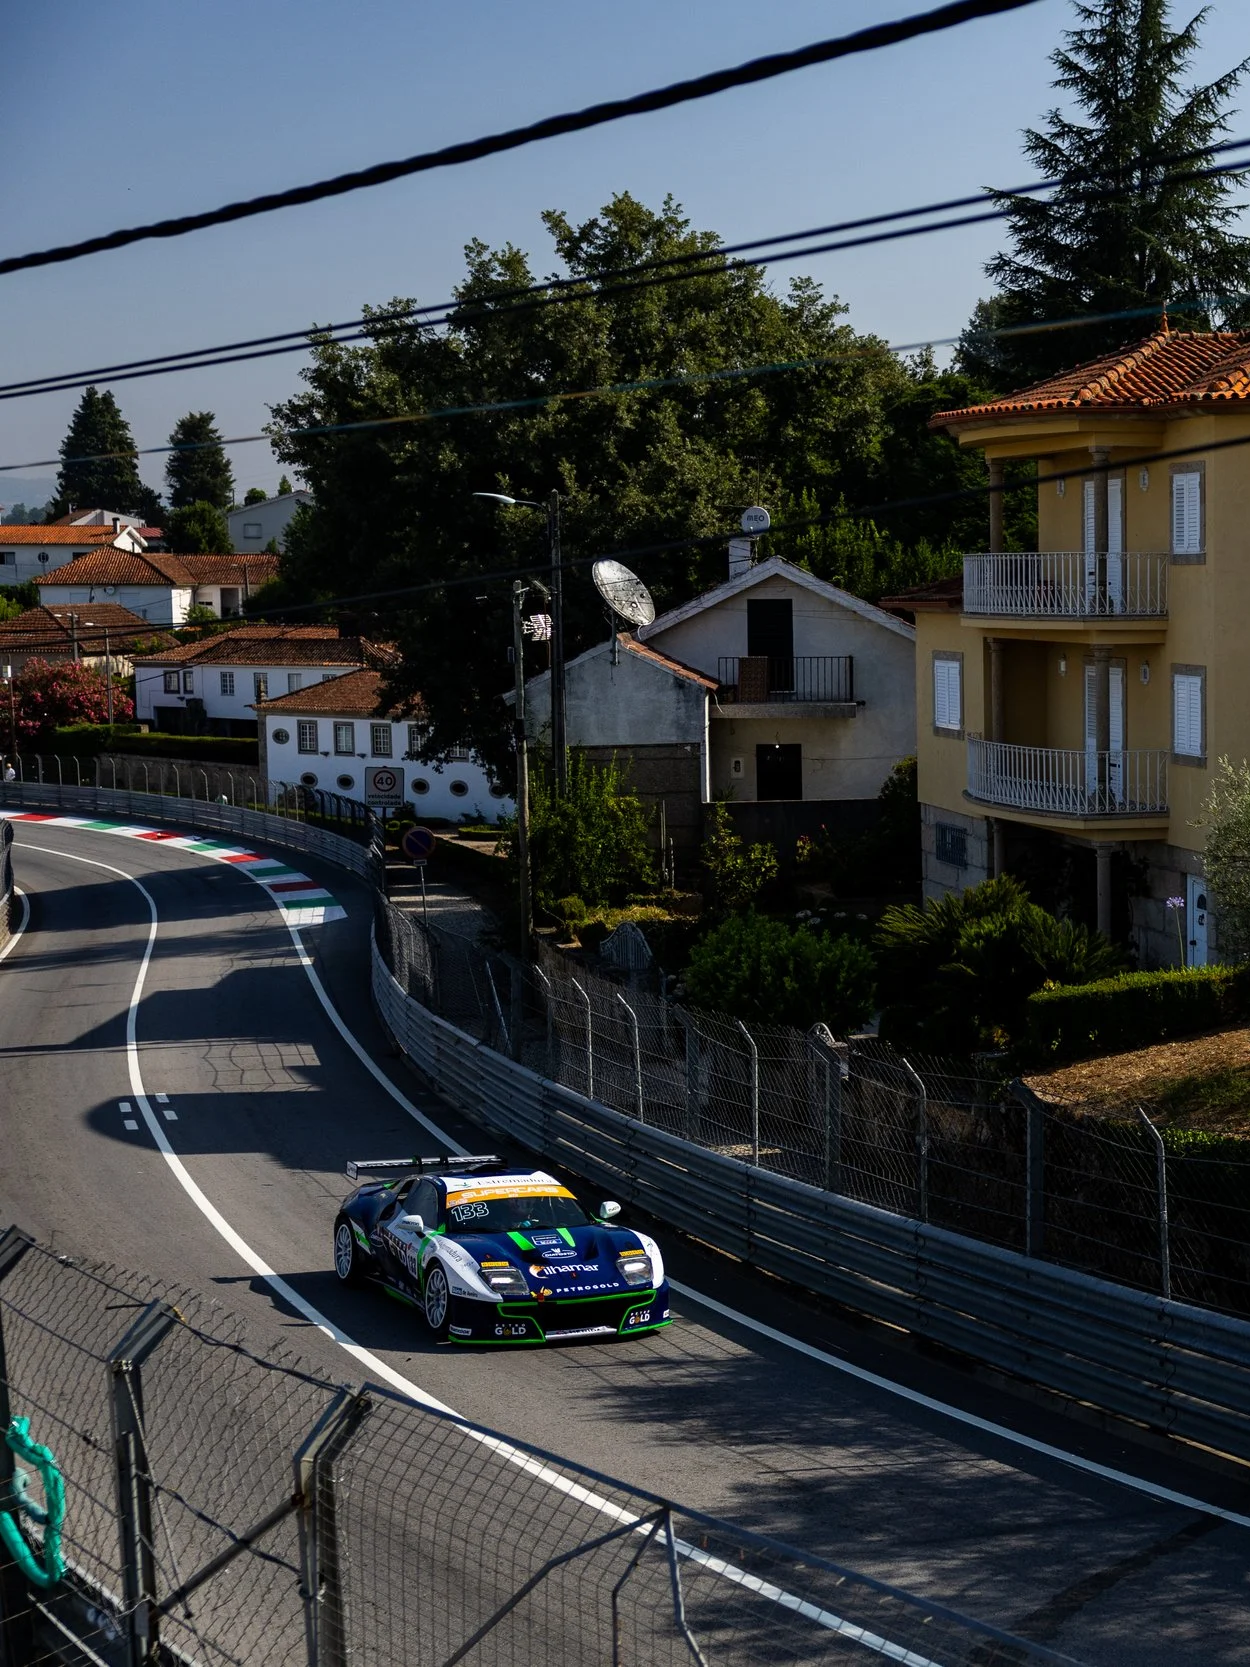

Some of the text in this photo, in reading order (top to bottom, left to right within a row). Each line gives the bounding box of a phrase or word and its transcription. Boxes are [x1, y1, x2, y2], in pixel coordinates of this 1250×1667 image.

[376, 777, 393, 786] 40
[461, 1186, 559, 1199] SUPERCARS
[451, 1201, 490, 1223] 133
[556, 1282, 620, 1294] PETROGOLD
